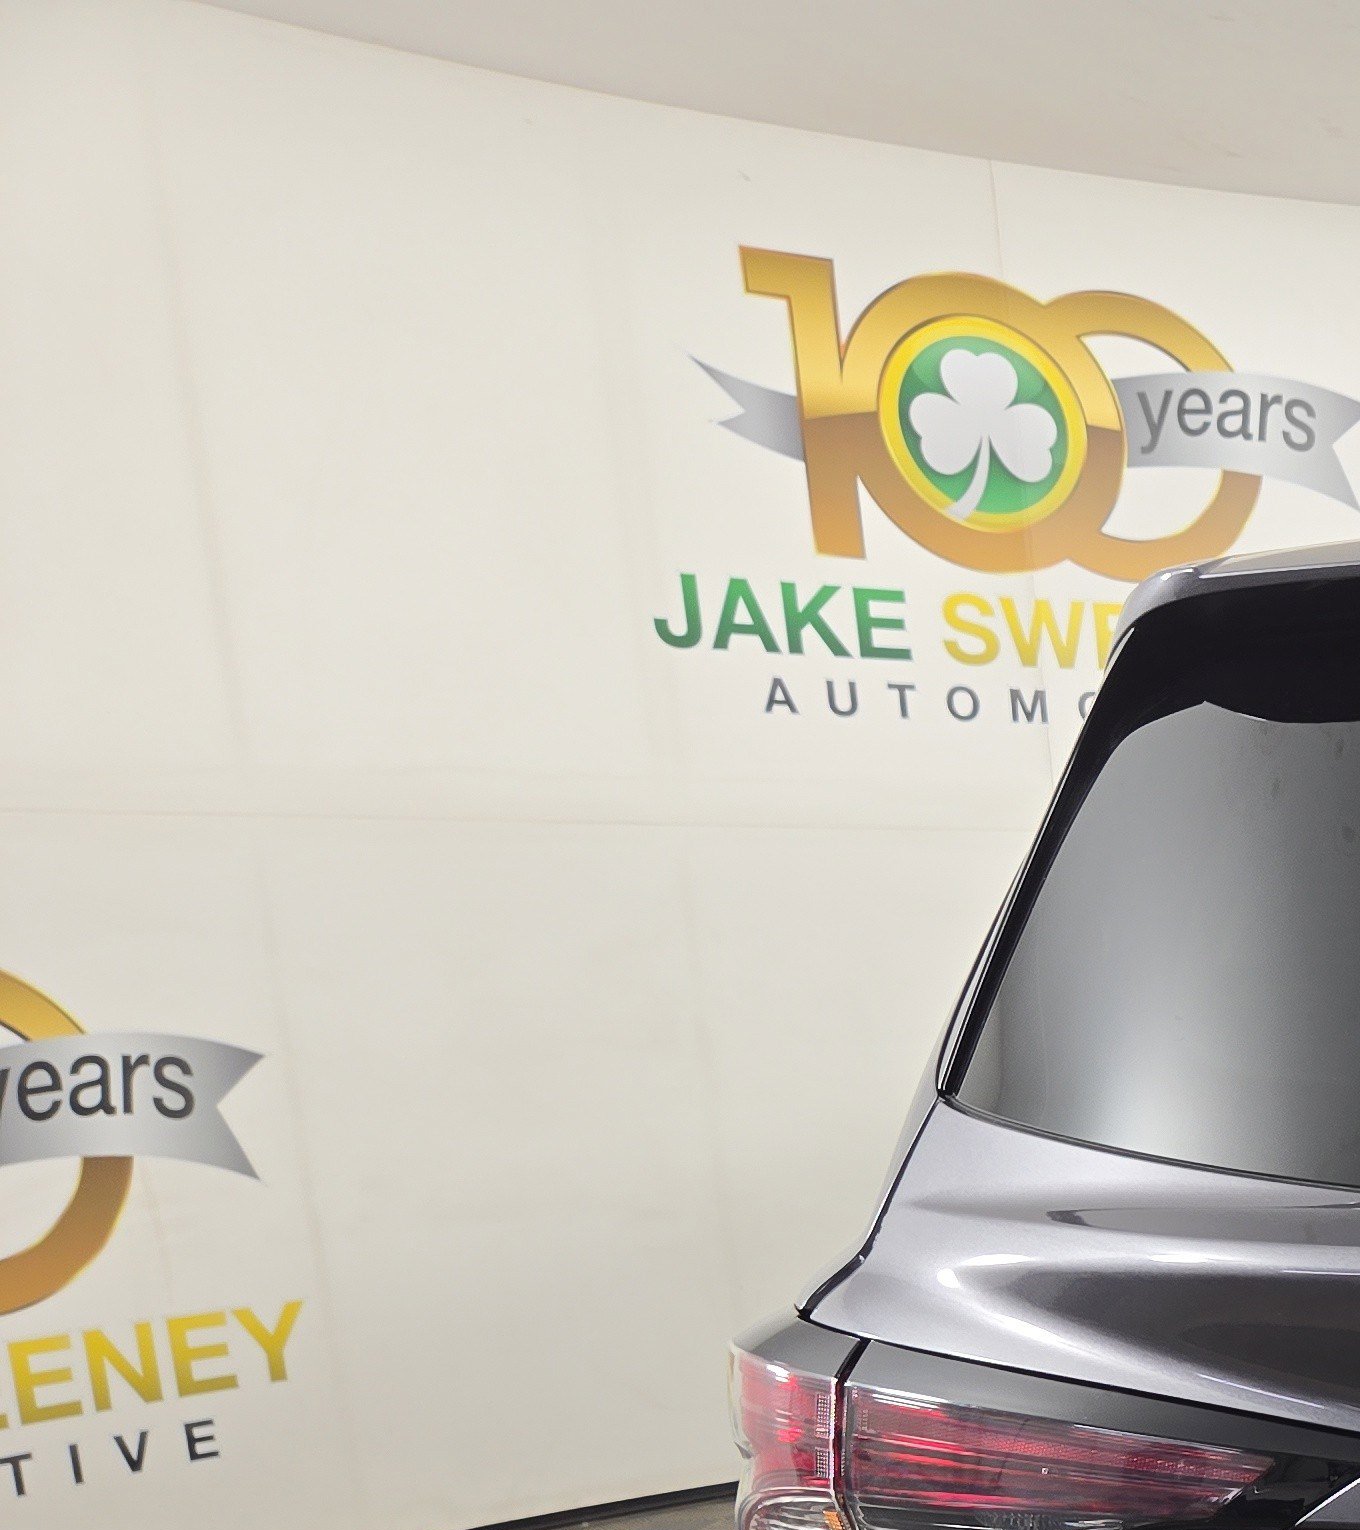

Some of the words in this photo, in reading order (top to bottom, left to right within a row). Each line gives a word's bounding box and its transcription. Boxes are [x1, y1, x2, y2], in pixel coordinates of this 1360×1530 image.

[738, 245, 1264, 583] 100
[1135, 381, 1317, 455] years
[653, 572, 914, 662] JAKE
[0, 1052, 196, 1122] ears
[0, 1300, 303, 1430] ENEY
[0, 1419, 220, 1496] TIVE
